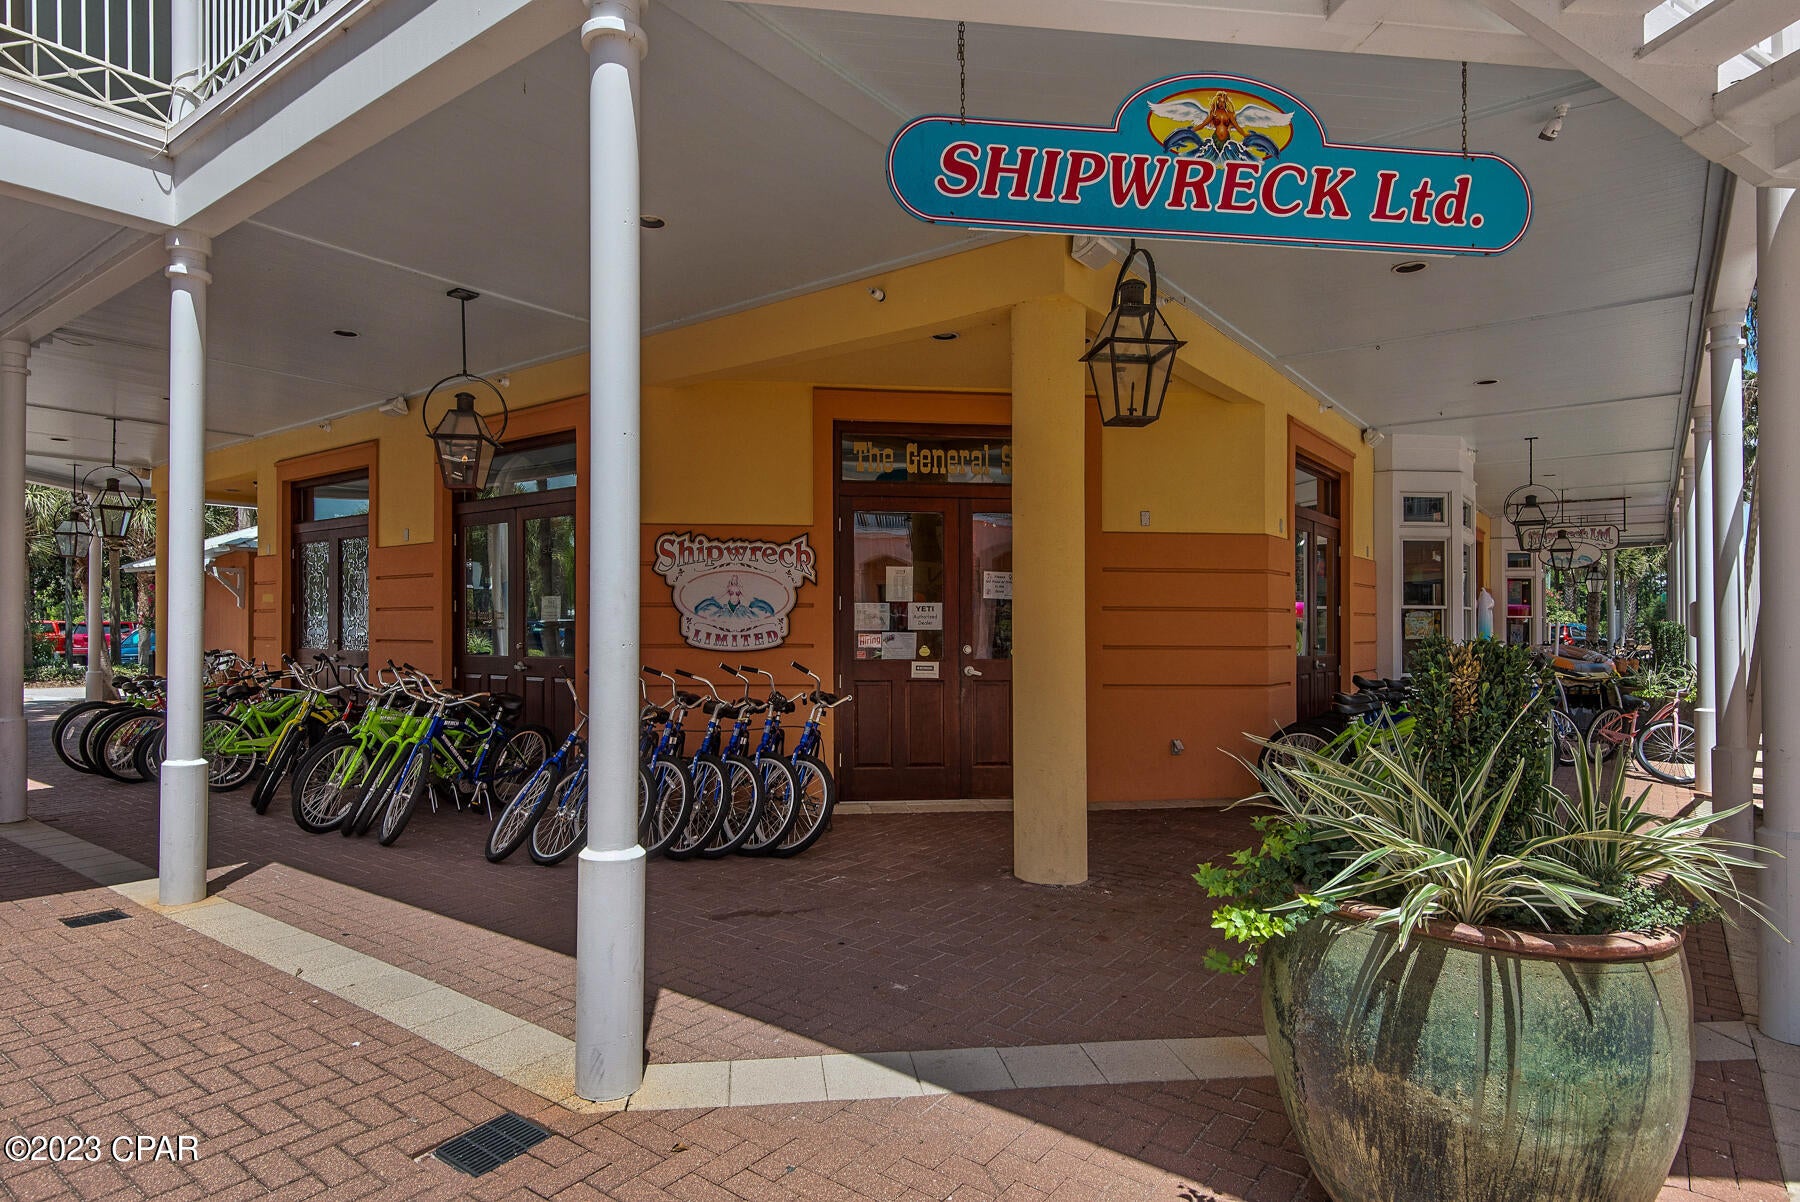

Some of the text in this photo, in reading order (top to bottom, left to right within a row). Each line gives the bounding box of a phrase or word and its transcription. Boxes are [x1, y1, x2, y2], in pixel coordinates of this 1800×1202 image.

[935, 140, 1485, 229] SHIPWRECK Ltd.
[853, 441, 1012, 475] The General S
[657, 537, 813, 577] Shipwreck
[691, 628, 779, 648] LIMITED
